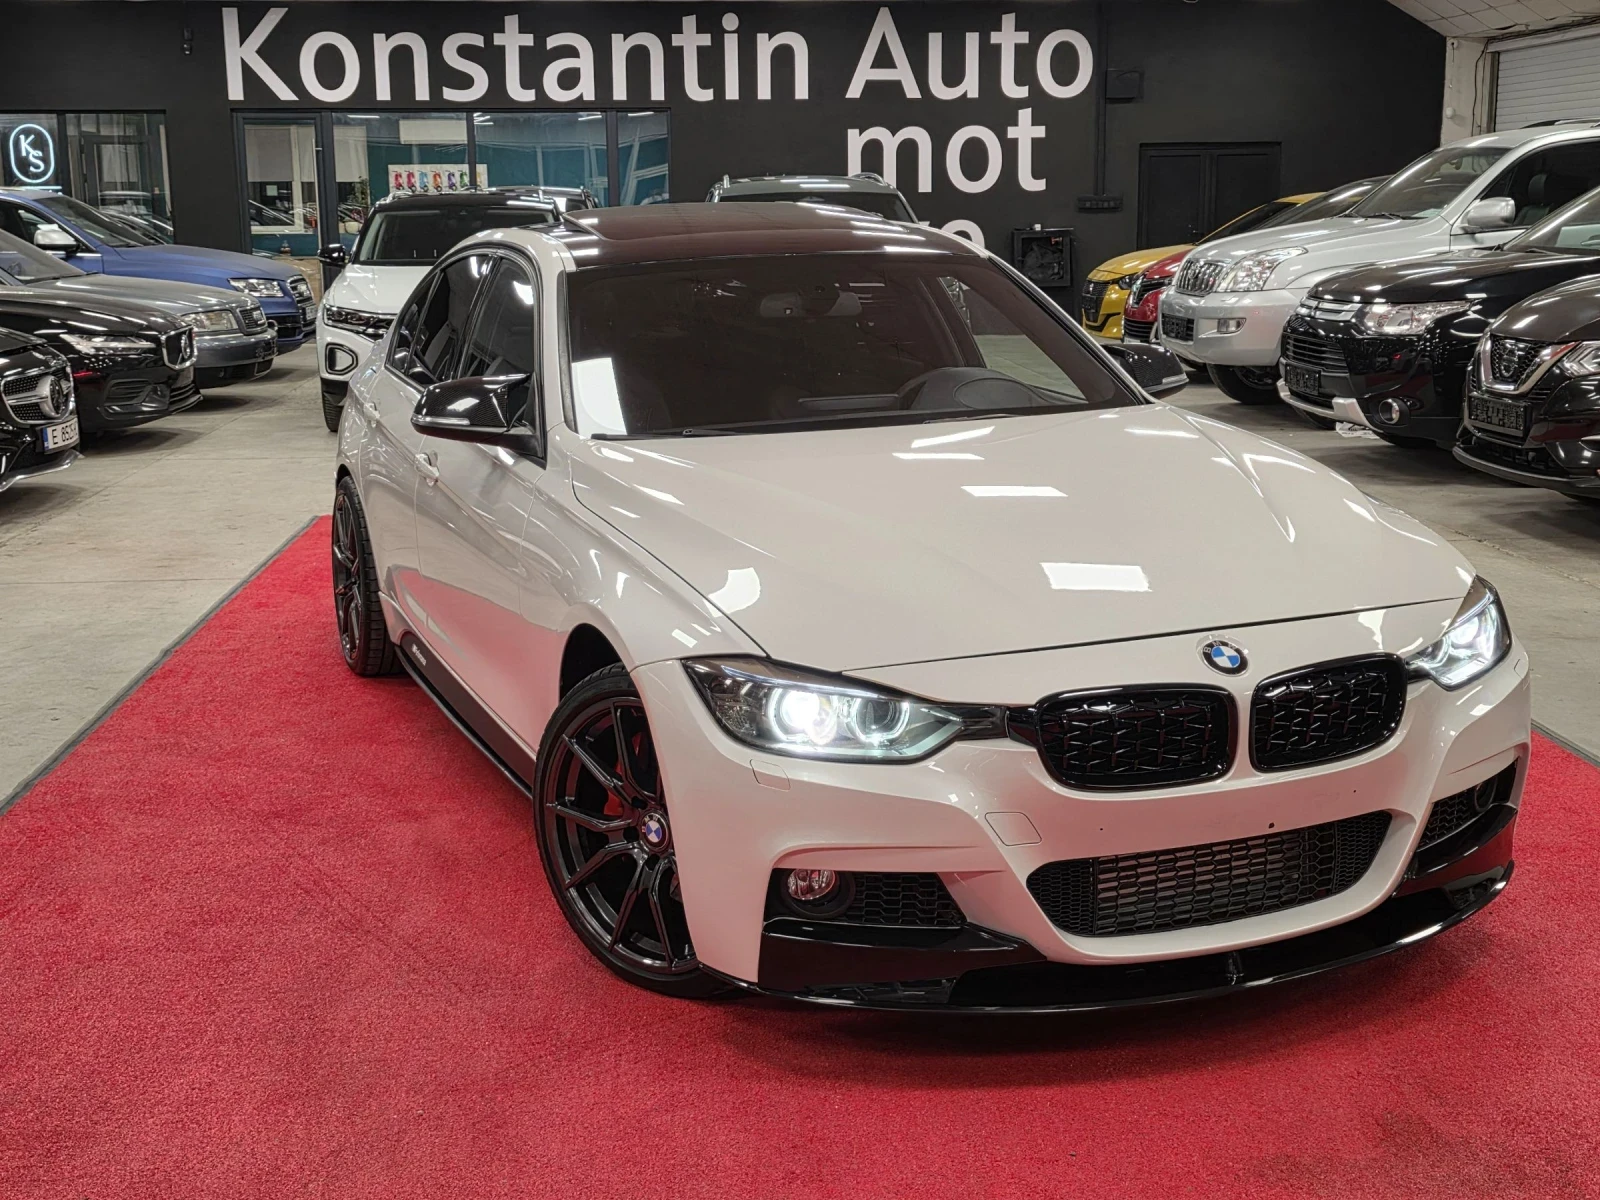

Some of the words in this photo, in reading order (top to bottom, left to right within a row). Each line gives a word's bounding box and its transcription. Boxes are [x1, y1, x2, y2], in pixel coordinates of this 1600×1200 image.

[222, 7, 809, 103] Konstantin
[845, 7, 1094, 99] Auto
[841, 107, 1047, 194] mot
[52, 428, 59, 445] E
